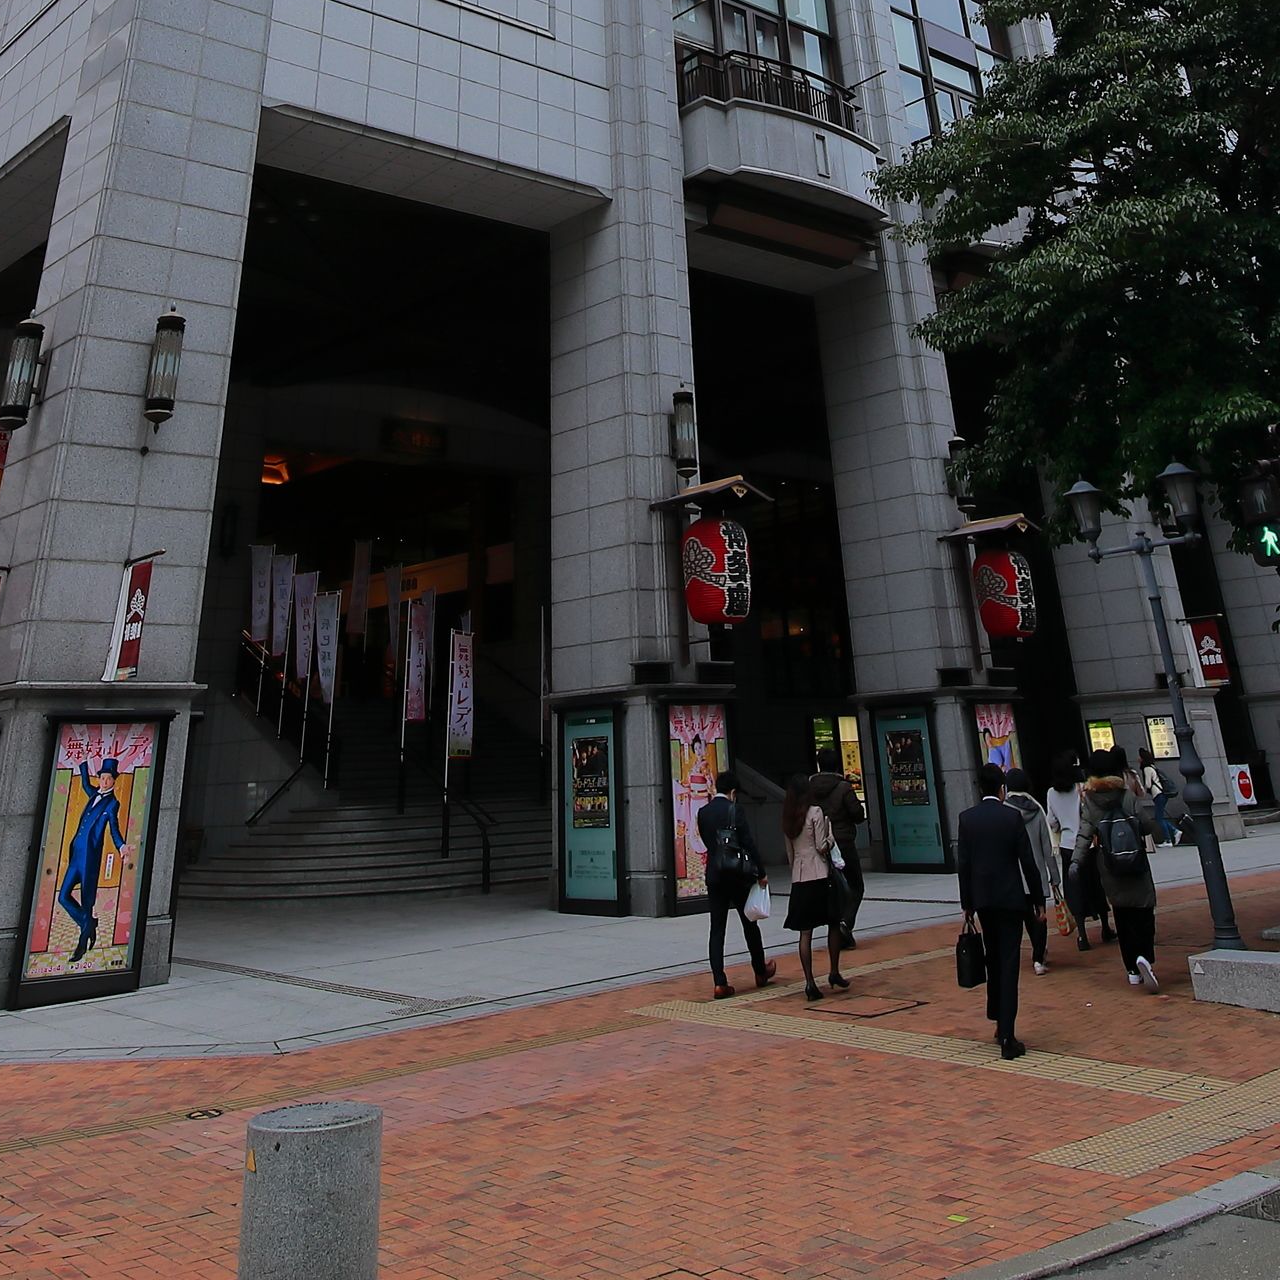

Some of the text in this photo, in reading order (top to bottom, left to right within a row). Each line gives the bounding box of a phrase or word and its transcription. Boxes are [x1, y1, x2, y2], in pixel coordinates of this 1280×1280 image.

[721, 521, 749, 616] 博多座
[1008, 551, 1037, 631] 博多座
[456, 643, 472, 731] 舞妓はレディ
[65, 735, 149, 761] 舞妓はレディ
